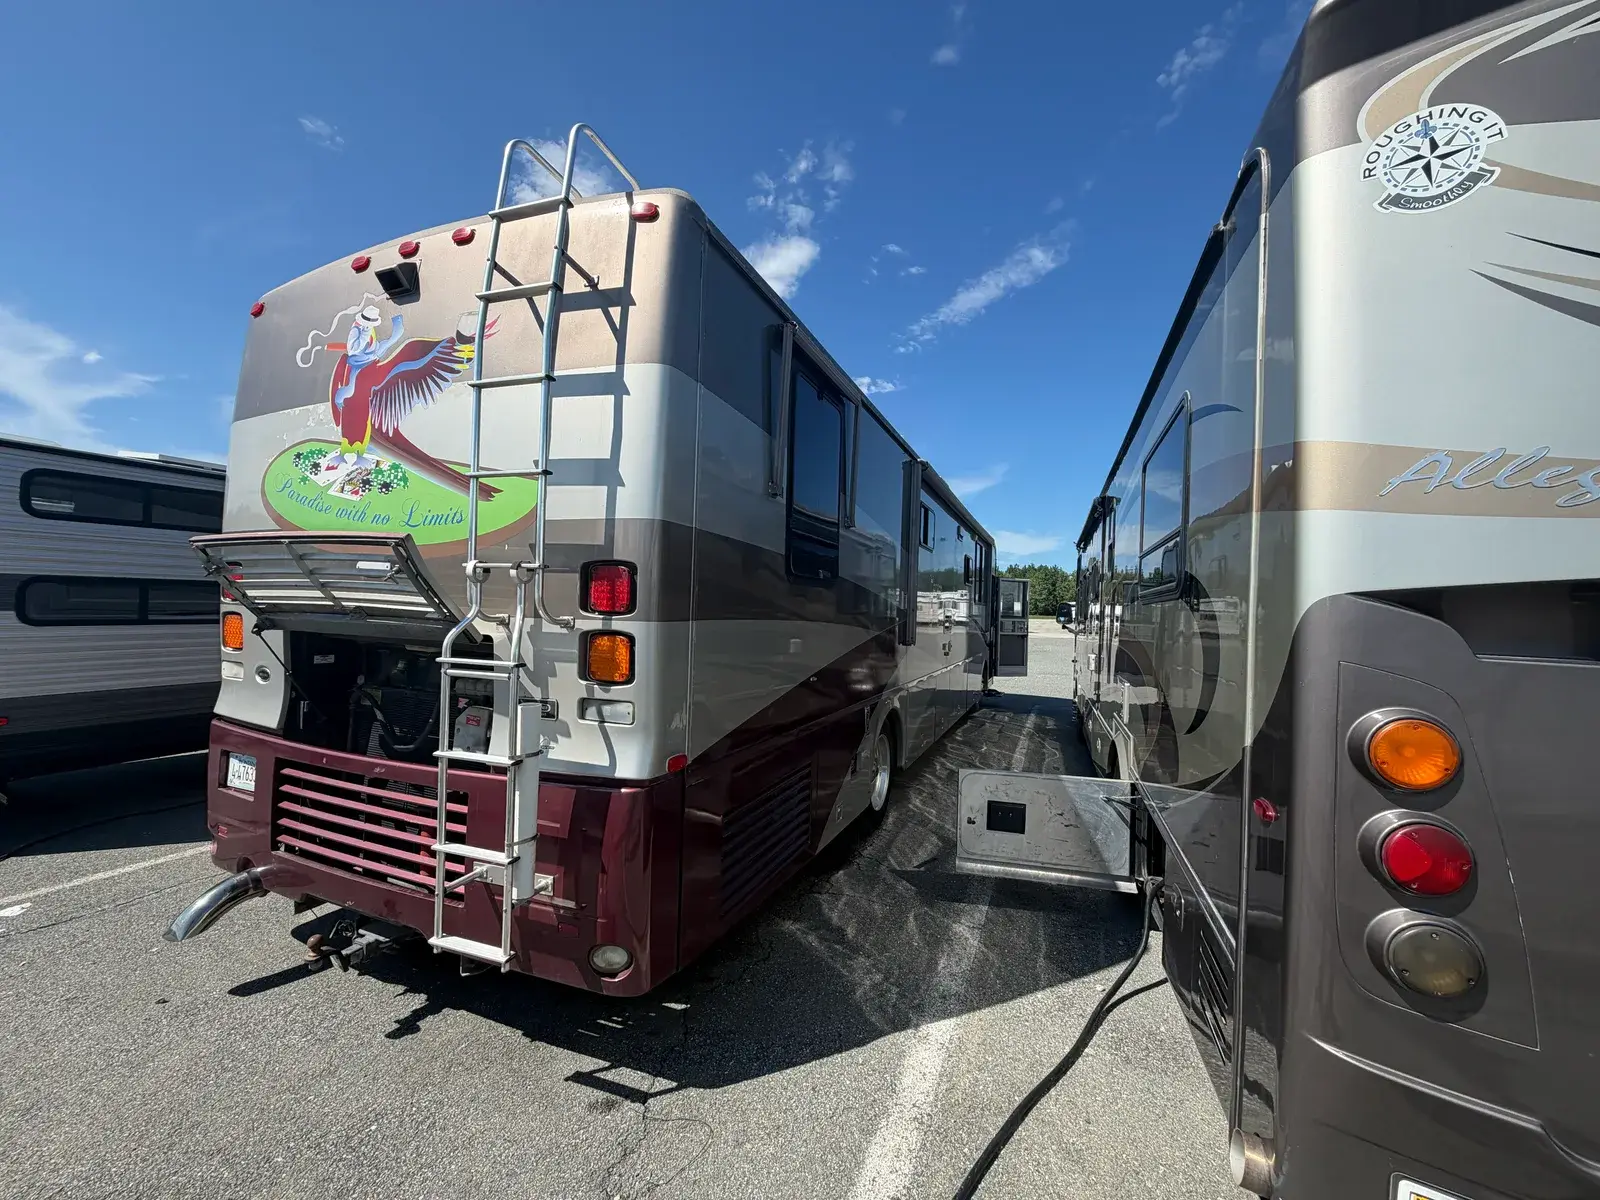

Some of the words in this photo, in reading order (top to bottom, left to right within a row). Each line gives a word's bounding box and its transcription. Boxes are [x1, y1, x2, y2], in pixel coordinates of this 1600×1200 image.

[1363, 107, 1488, 180] ROUGHING
[1482, 122, 1505, 140] IT
[1398, 180, 1474, 210] Smoothly
[274, 472, 333, 515] Paradise
[335, 501, 372, 524] with
[371, 513, 393, 527] no
[399, 497, 469, 529] Limits
